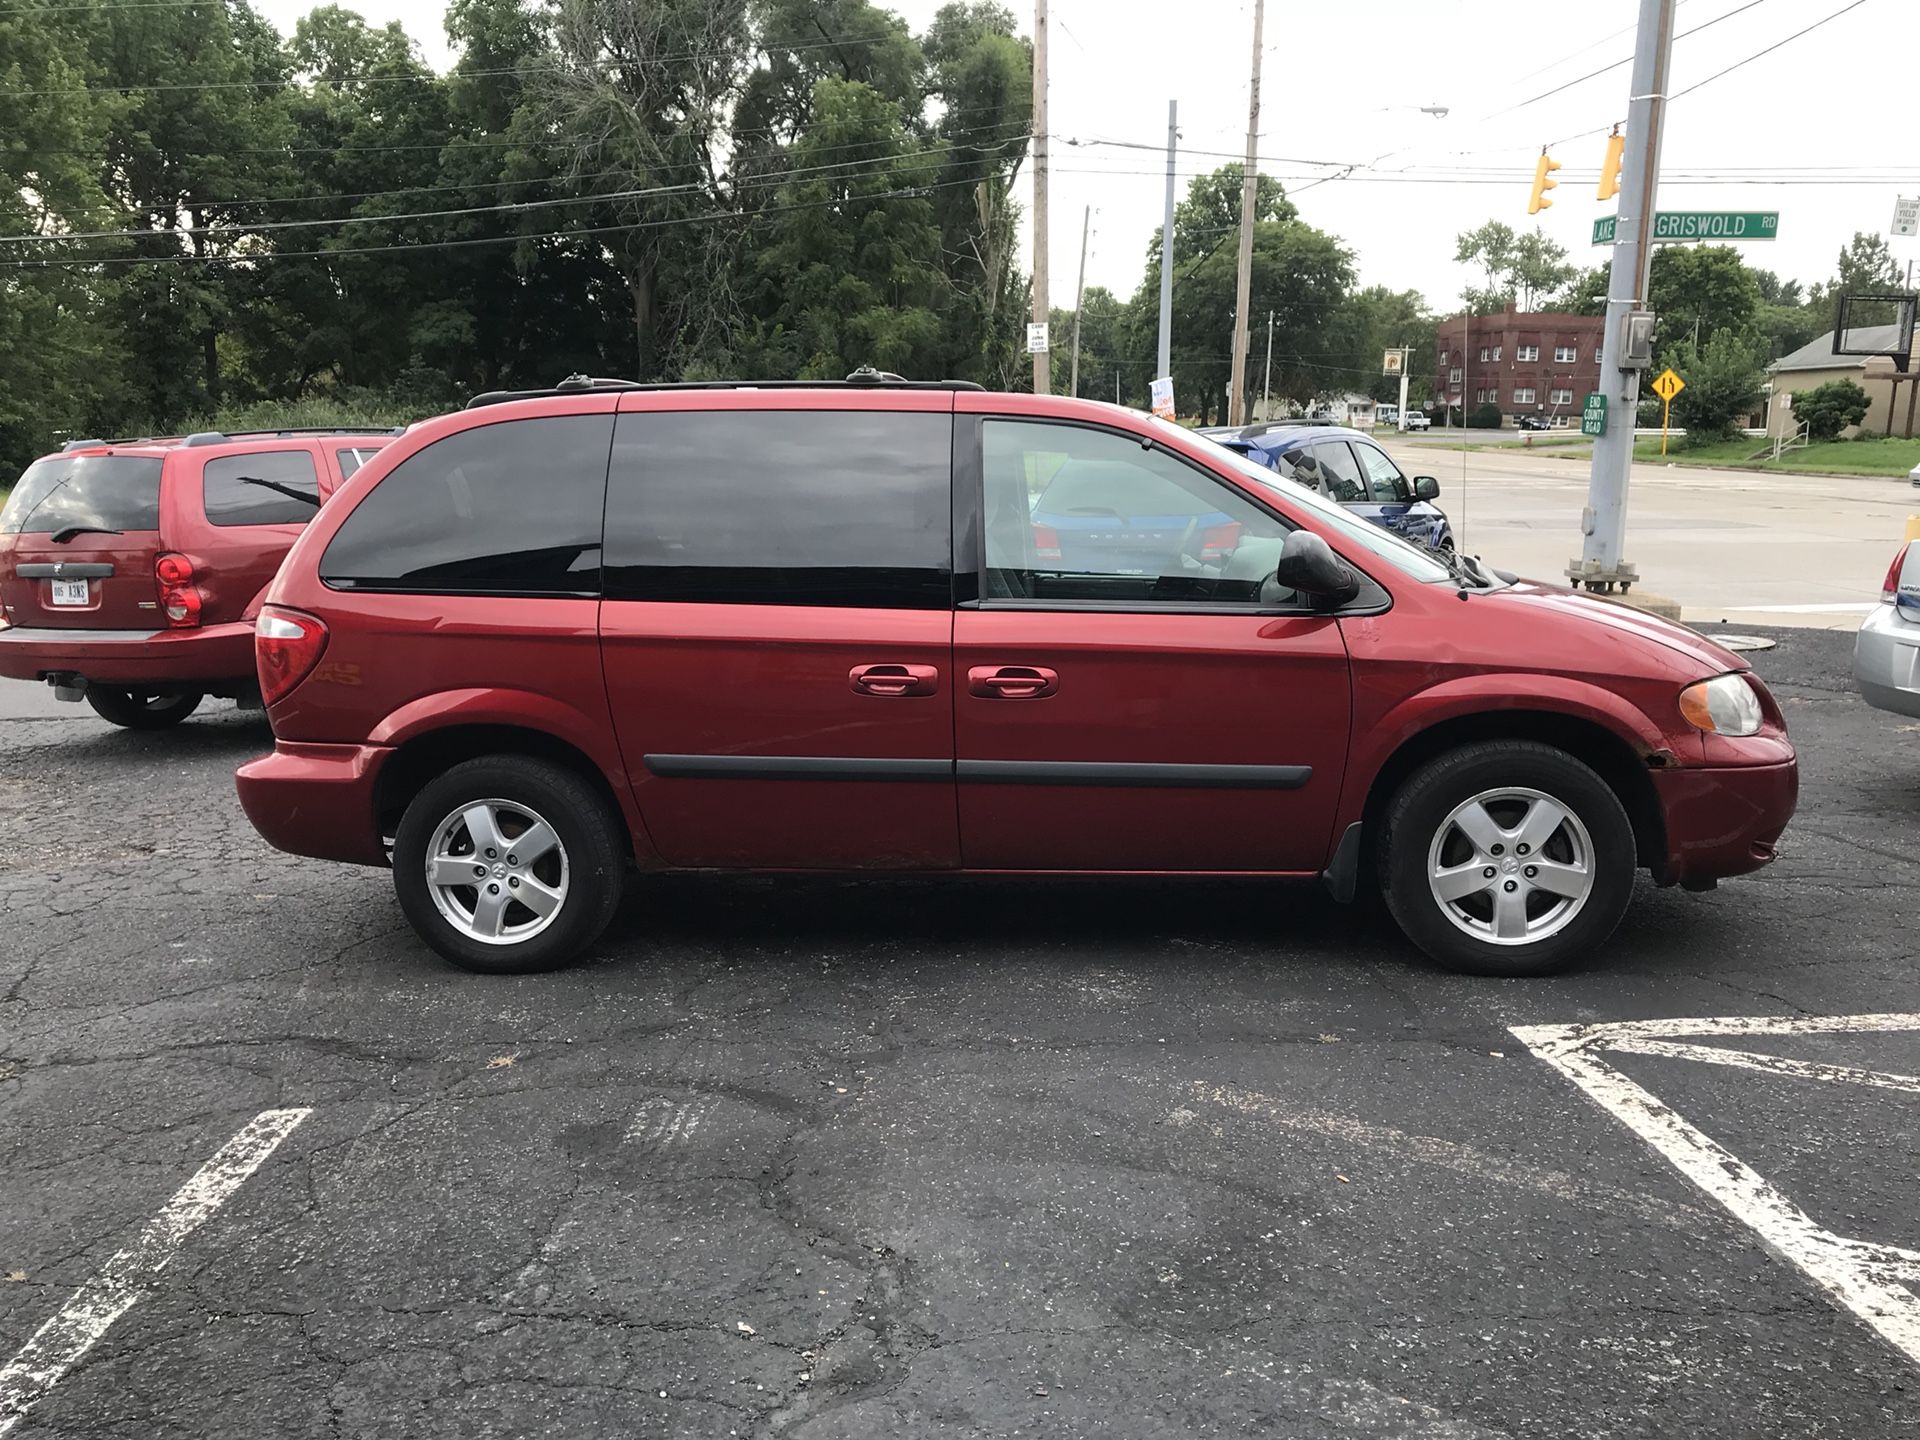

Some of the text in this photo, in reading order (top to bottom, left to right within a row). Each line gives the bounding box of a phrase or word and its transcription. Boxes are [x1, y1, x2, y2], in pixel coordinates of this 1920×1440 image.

[1899, 209, 1917, 218] YIELD
[1593, 220, 1614, 242] LAKE
[1656, 215, 1777, 236] GRISWOLD RD
[1590, 396, 1601, 408] END
[1584, 409, 1605, 421] COUNTY
[1585, 420, 1601, 433] ROAD
